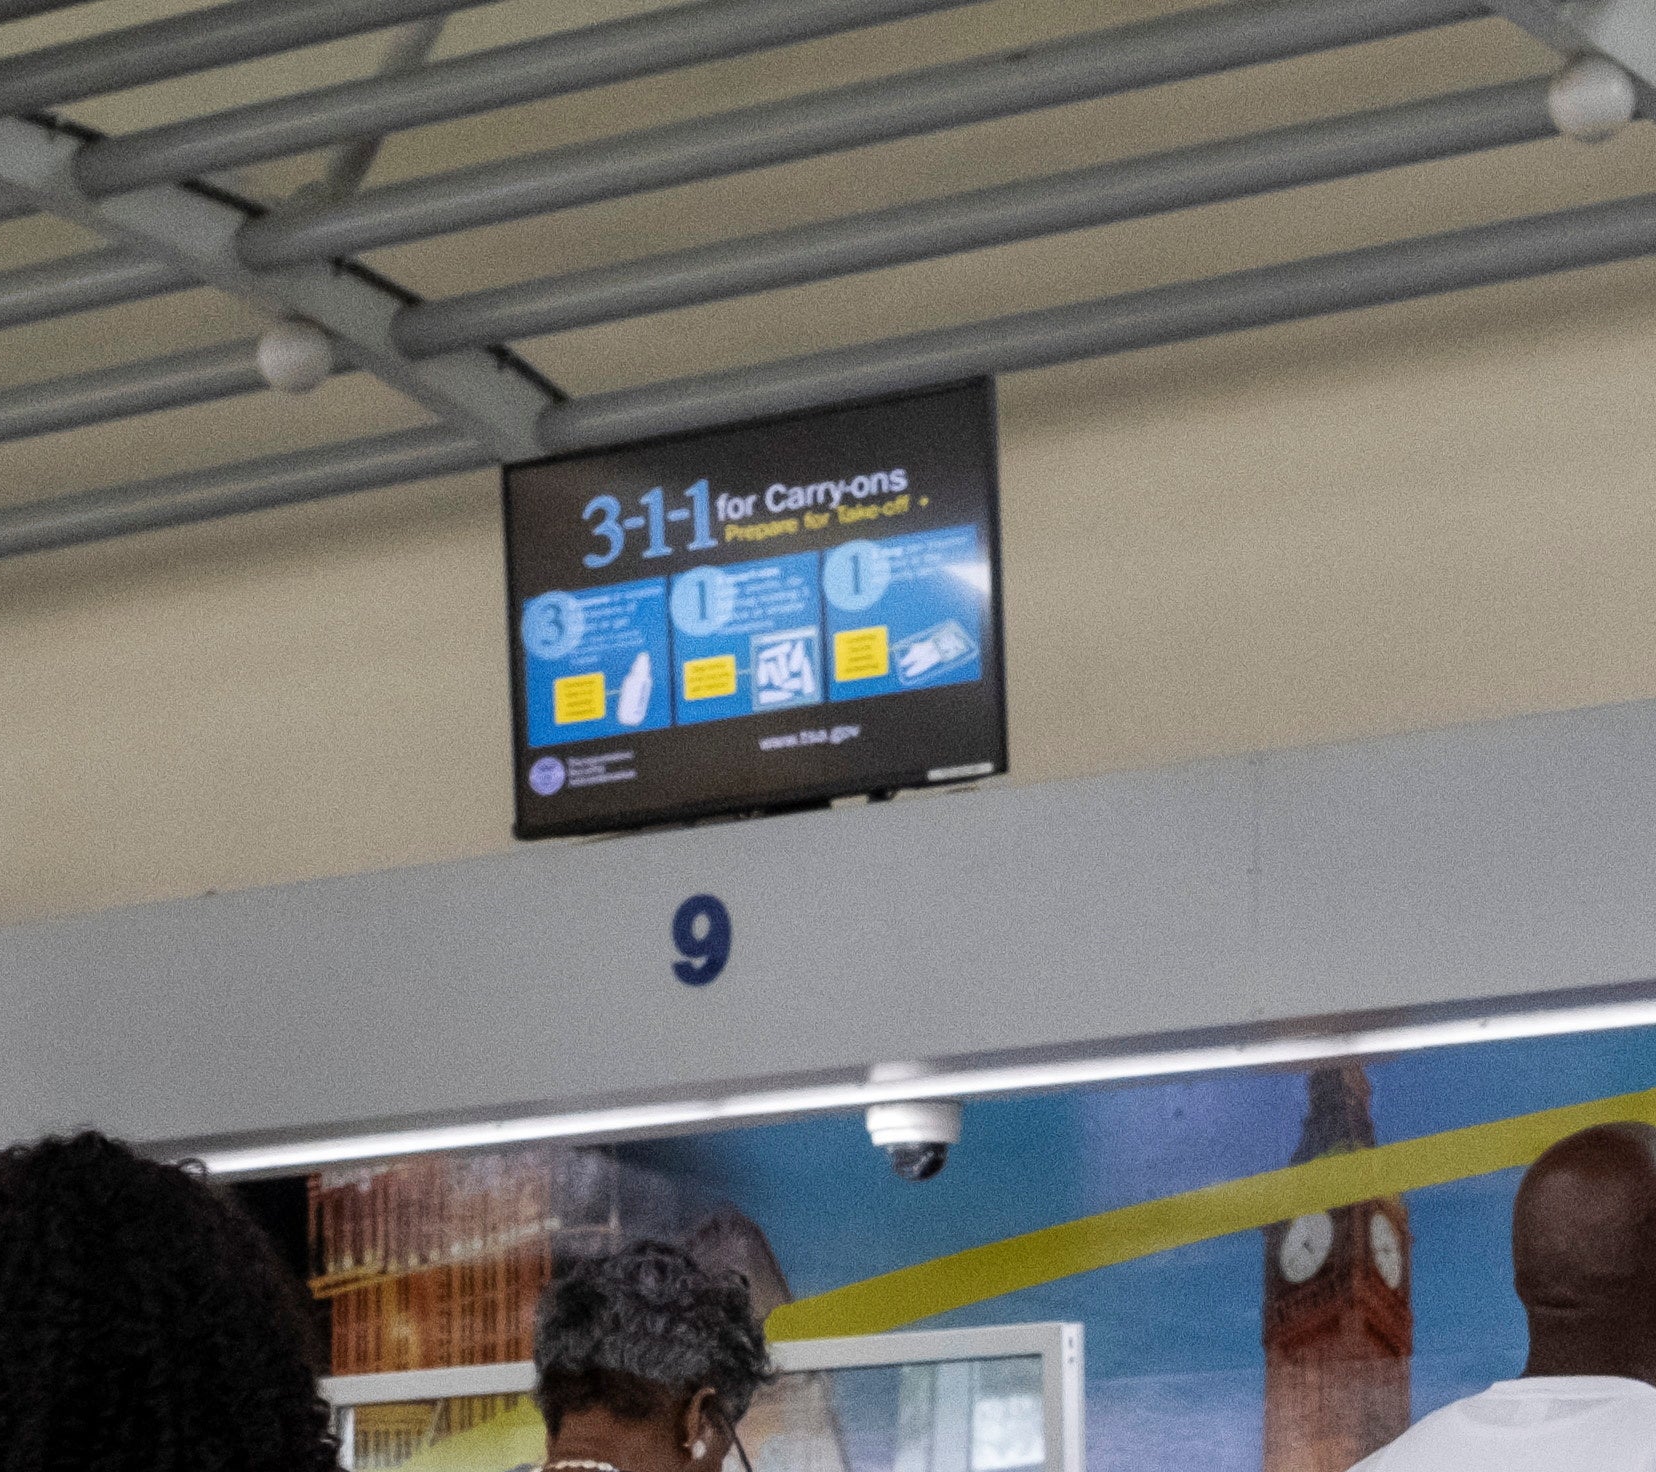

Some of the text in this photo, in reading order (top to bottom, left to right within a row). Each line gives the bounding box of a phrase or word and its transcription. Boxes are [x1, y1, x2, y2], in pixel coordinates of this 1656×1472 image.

[582, 467, 910, 568] 3-1-1 for Carry-ons
[671, 893, 733, 988] 9
